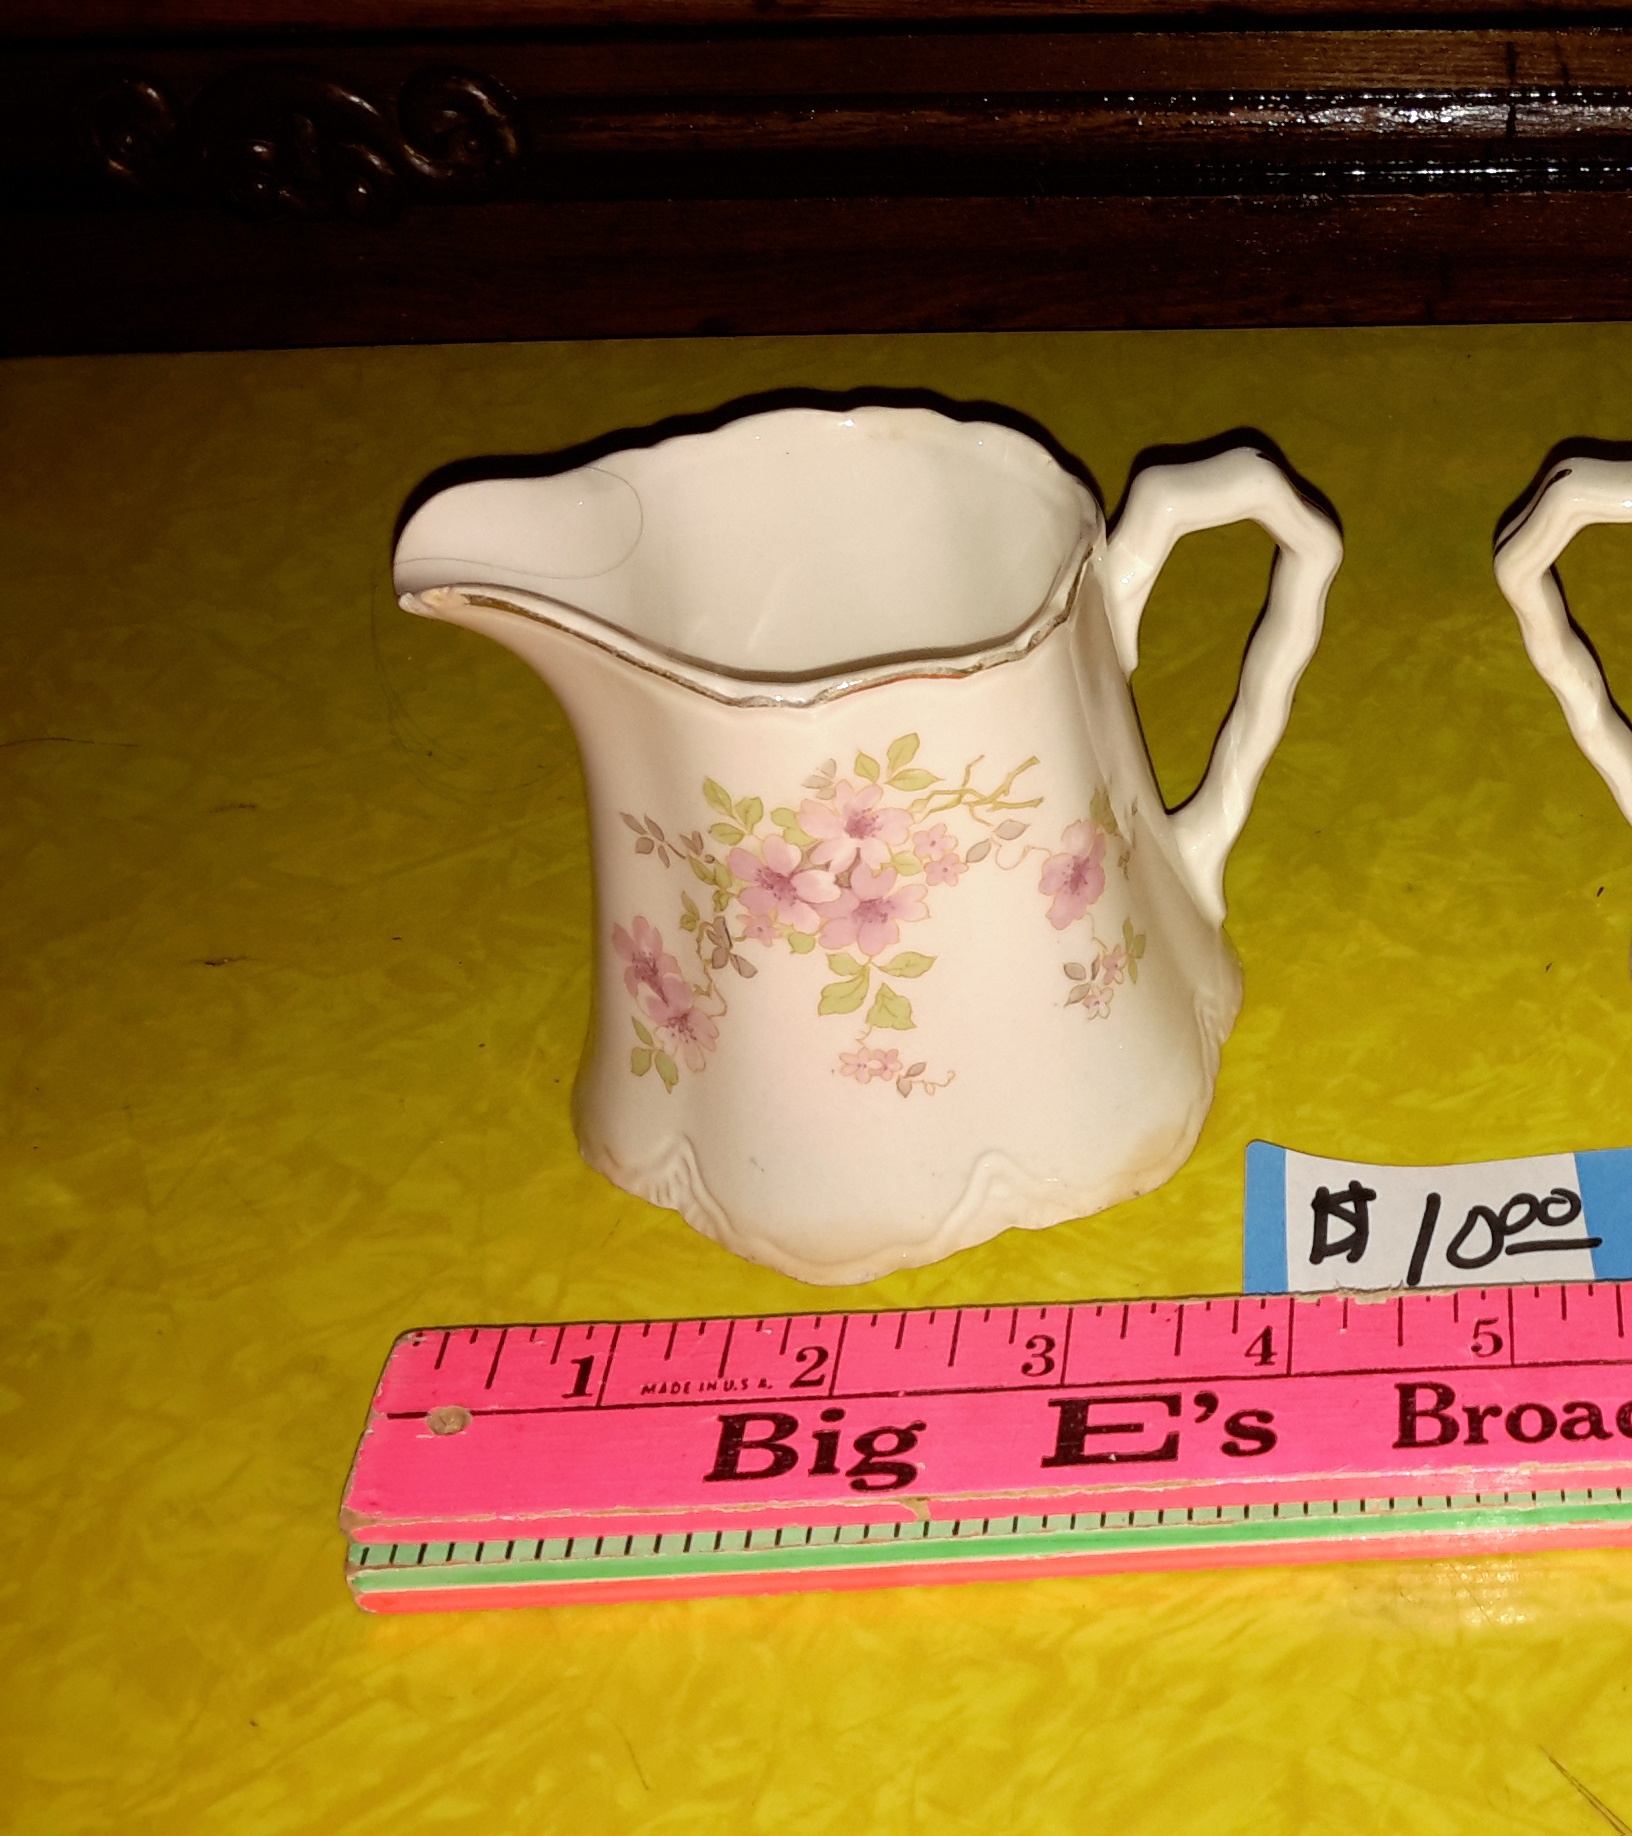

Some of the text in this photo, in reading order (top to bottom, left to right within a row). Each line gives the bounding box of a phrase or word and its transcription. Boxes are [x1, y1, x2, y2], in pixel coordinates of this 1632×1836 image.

[563, 1355, 597, 1399] 1
[789, 1346, 829, 1389] 2
[1021, 1335, 1056, 1377] 3
[1244, 1327, 1276, 1366] 4
[1471, 1318, 1504, 1358] 5
[640, 1378, 774, 1395] MADE IN U.SA.
[703, 1408, 927, 1493] Big
[1041, 1391, 1278, 1469] E's
